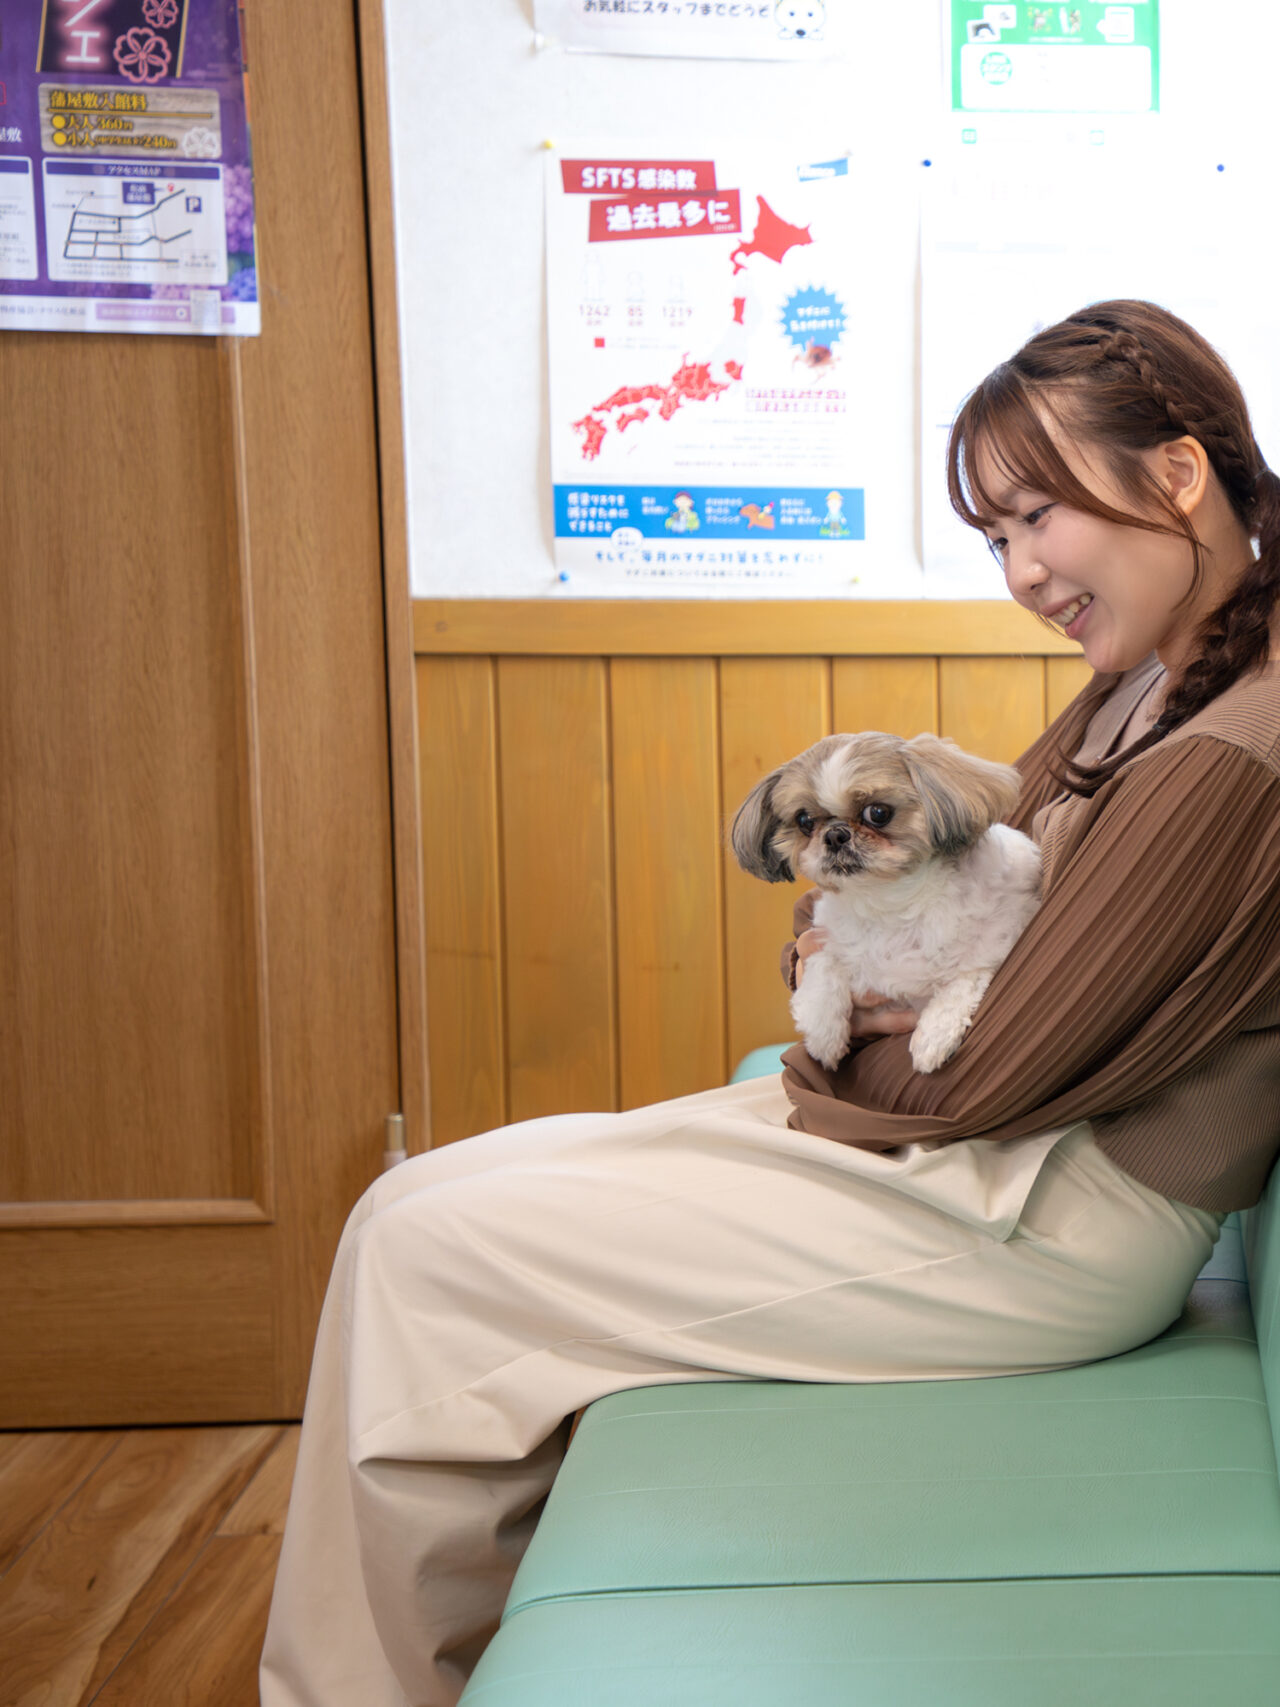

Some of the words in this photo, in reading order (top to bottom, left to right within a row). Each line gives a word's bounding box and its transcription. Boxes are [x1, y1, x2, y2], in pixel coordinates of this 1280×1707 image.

[189, 198, 200, 211] P
[606, 200, 731, 232] 過去最多に
